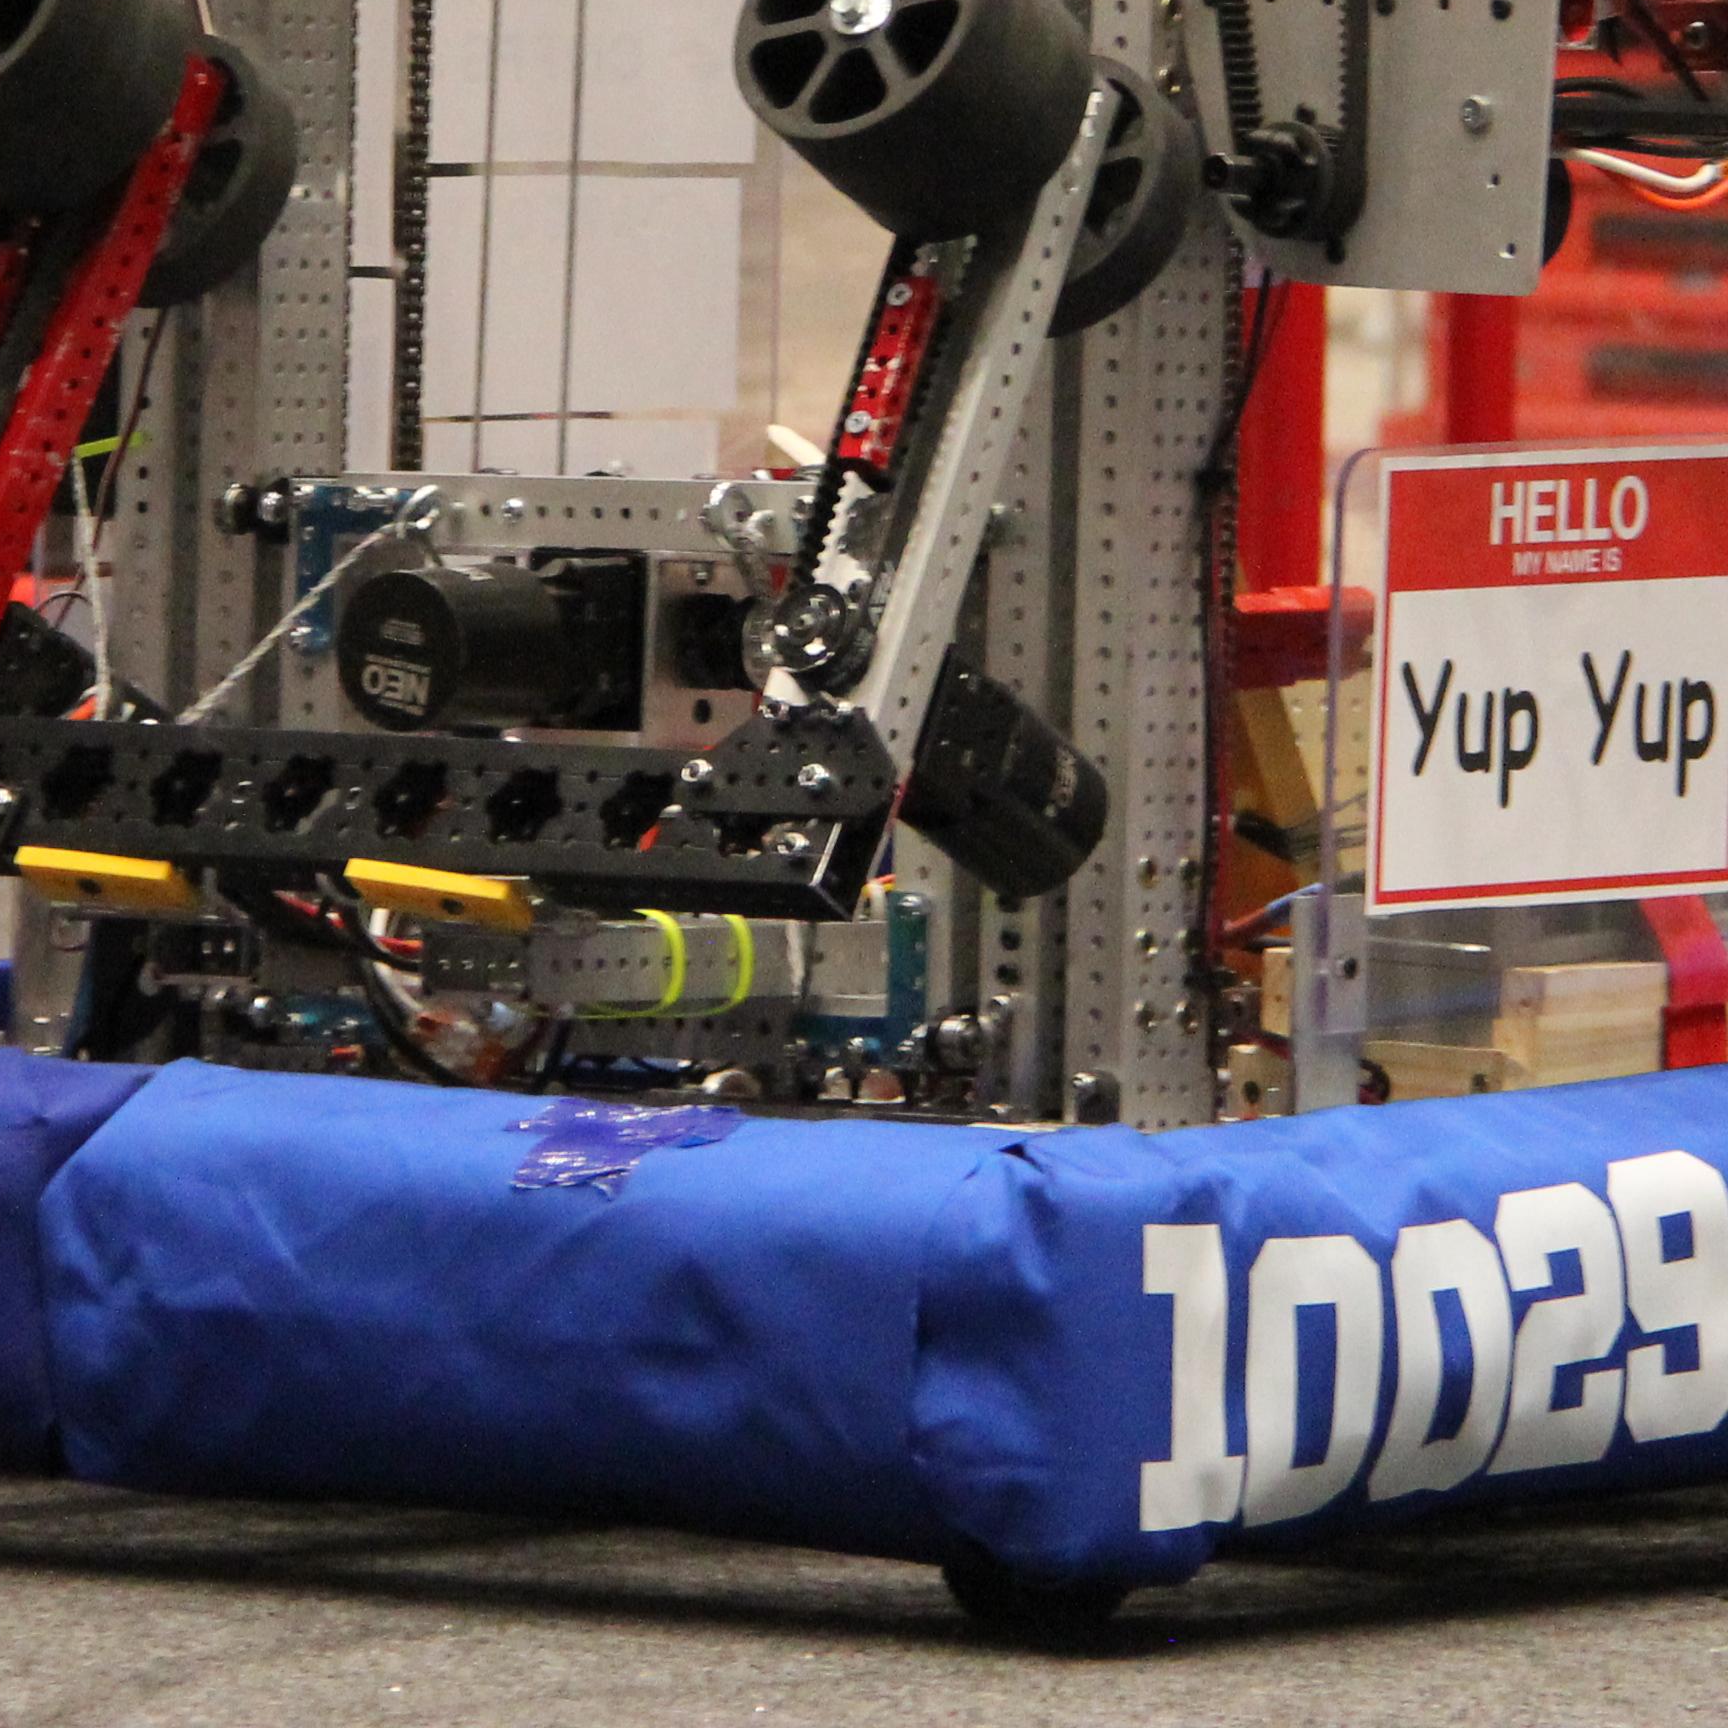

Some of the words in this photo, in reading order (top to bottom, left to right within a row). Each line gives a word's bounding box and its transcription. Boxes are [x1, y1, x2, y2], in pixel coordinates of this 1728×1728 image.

[1489, 475, 1650, 545] HELLO
[1512, 551, 1543, 576] MY
[1546, 548, 1602, 574] NAME
[1603, 546, 1623, 572] IS
[1401, 658, 1539, 809] Yup
[1580, 648, 1716, 797] Yup
